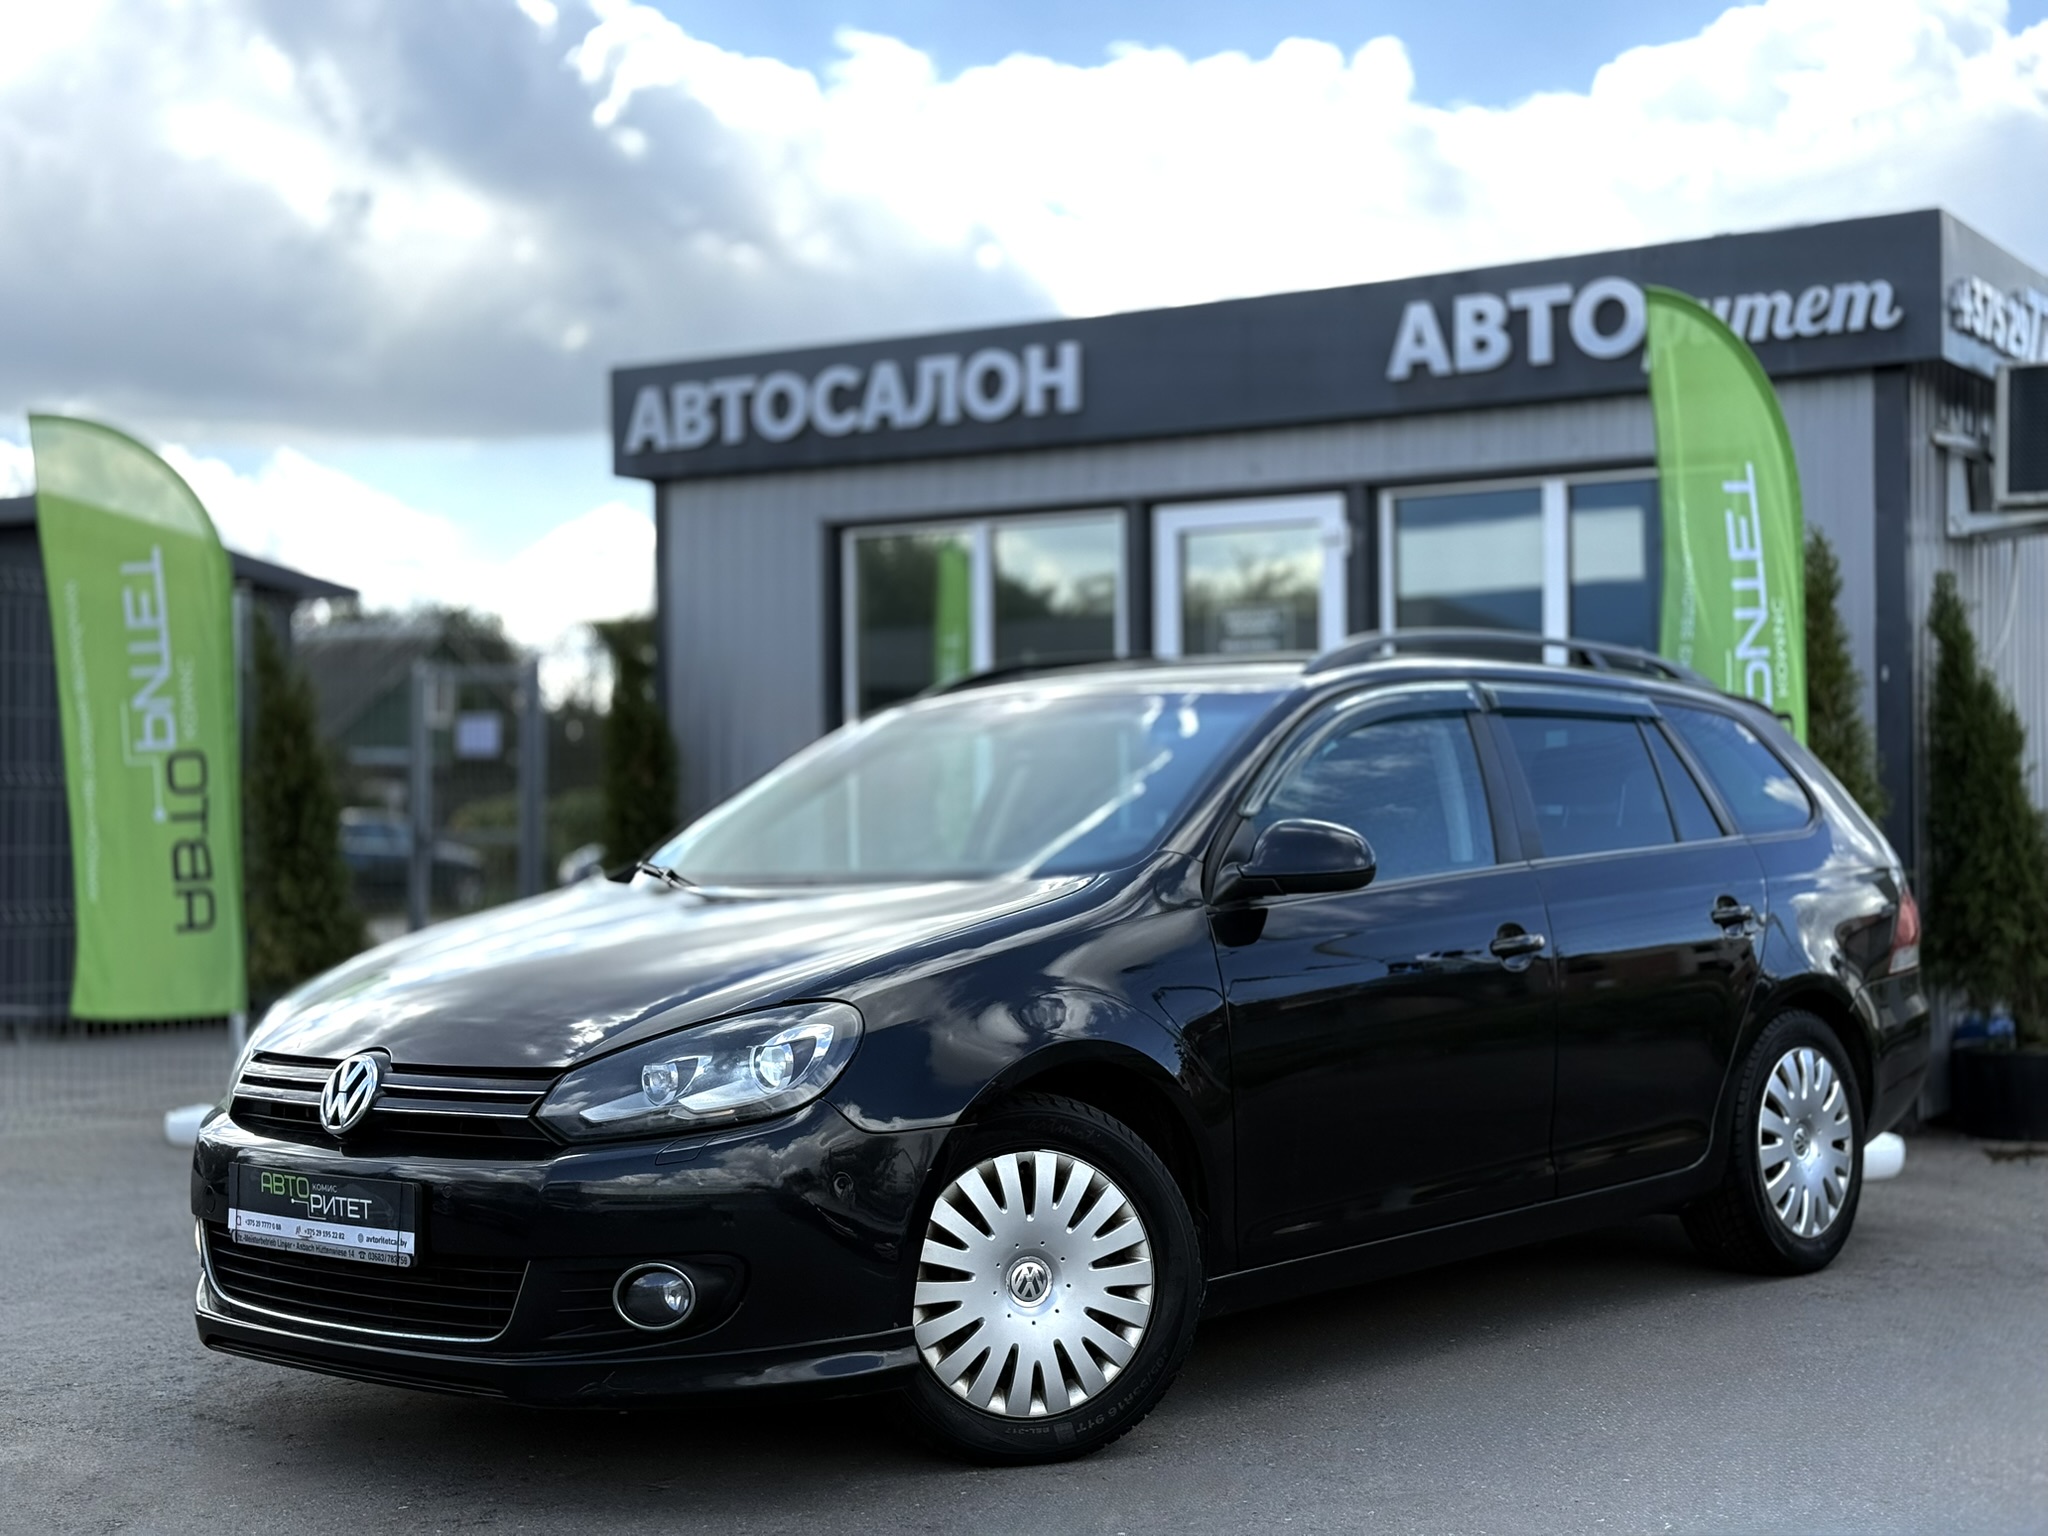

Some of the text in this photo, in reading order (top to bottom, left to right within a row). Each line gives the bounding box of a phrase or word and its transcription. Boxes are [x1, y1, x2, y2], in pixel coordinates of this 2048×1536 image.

[624, 340, 1081, 455] АВТОСАЛОН
[261, 1171, 310, 1199] АВТО
[312, 1183, 338, 1194] КОМИС
[310, 1194, 372, 1220] РИТЕТ
